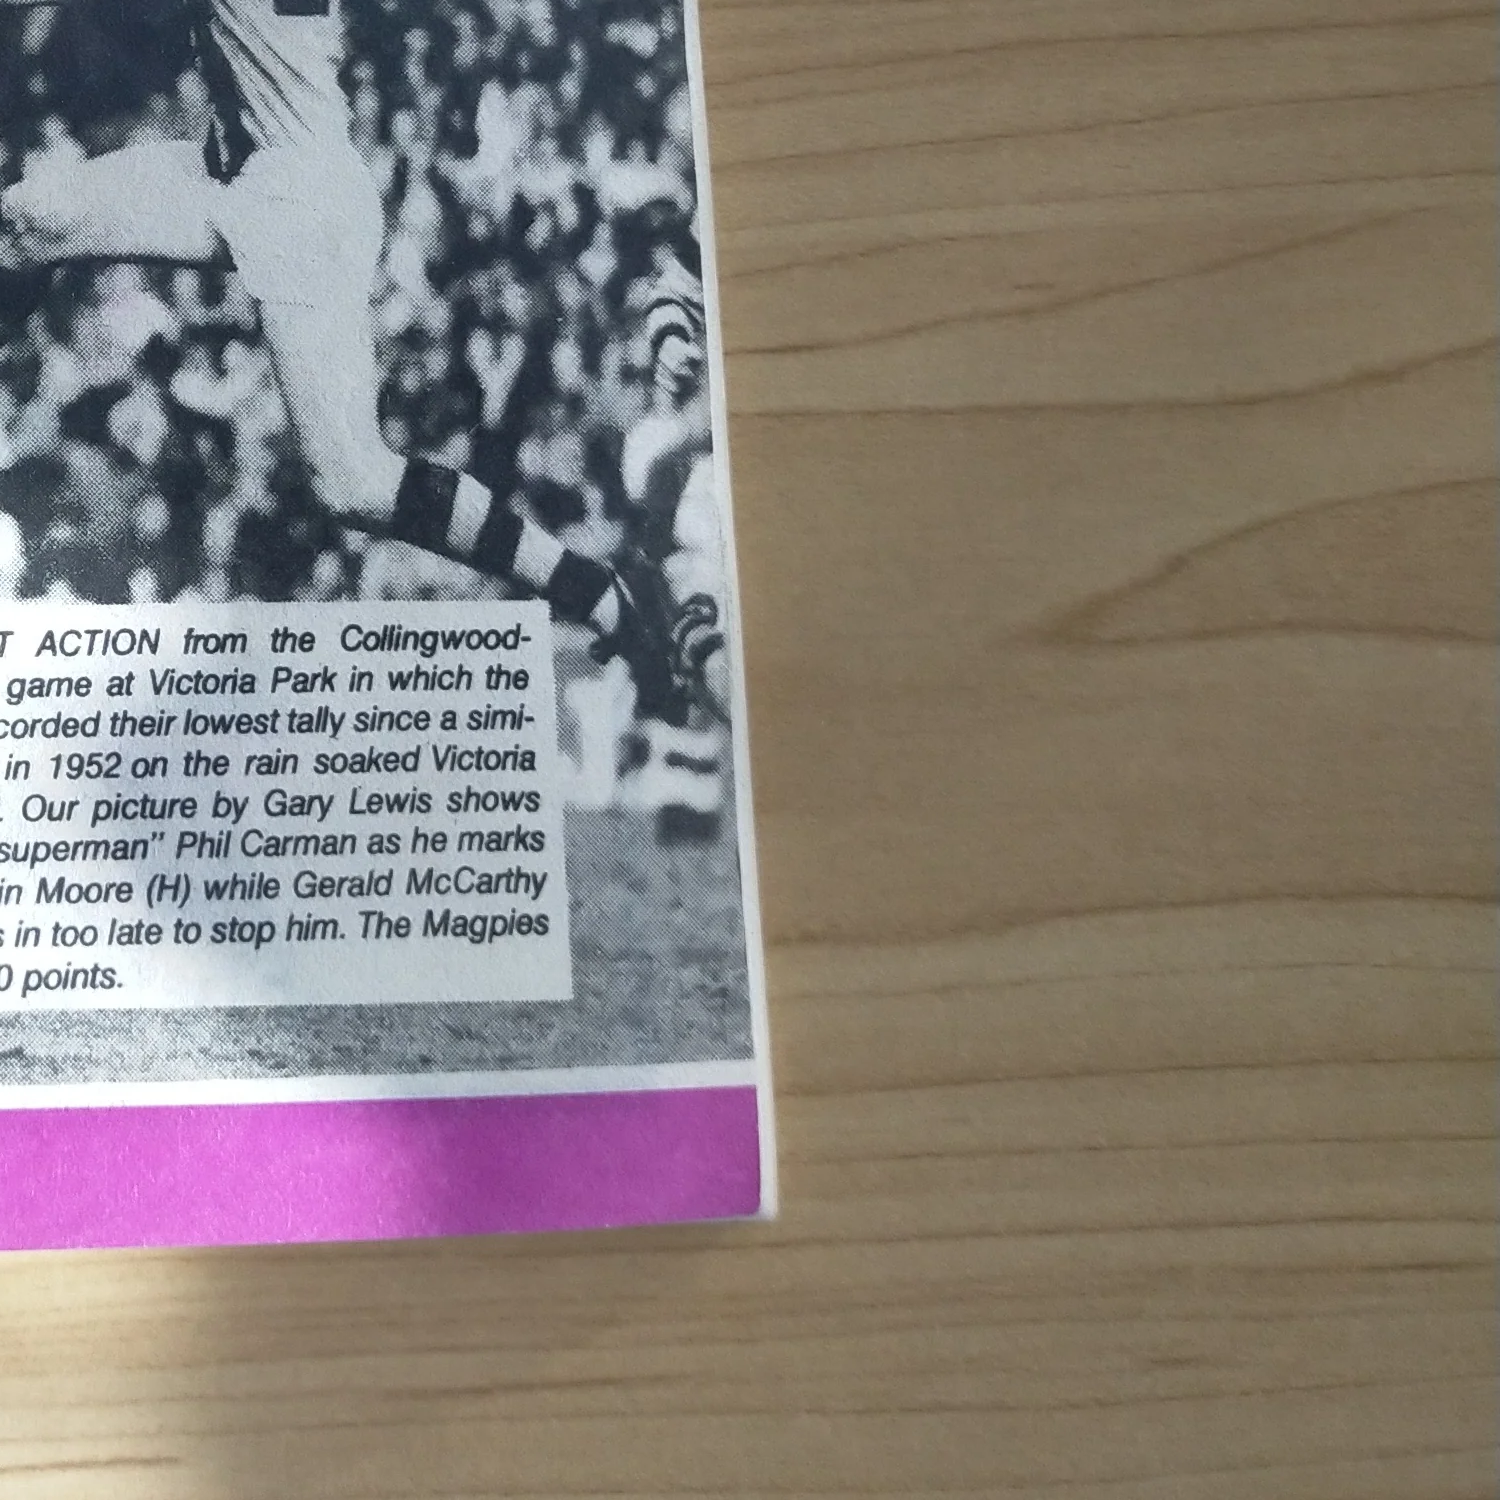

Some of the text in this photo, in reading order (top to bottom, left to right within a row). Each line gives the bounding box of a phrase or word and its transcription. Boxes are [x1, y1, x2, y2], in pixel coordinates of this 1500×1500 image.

[36, 628, 160, 657] ACTION
[184, 628, 247, 654] from
[271, 627, 315, 653] the
[341, 623, 531, 658] Collingwood-
[7, 677, 92, 705] game
[106, 672, 135, 697] at
[150, 667, 256, 695] Victoria
[271, 666, 337, 693] Park
[349, 666, 374, 692] in
[388, 664, 472, 691] which
[486, 664, 529, 690] the
[110, 710, 177, 737] their
[184, 709, 280, 735] lowest
[287, 706, 345, 739] tally
[354, 706, 431, 733] since
[440, 710, 457, 731] a
[467, 704, 534, 731] simi-
[5, 754, 30, 780] in
[51, 752, 122, 780] 1952
[131, 757, 168, 779] on
[184, 750, 229, 777] the
[245, 748, 298, 775] rain
[314, 745, 421, 774] soaked
[432, 744, 536, 771] Victoria
[22, 794, 80, 822] Our
[91, 793, 197, 827] picture
[212, 791, 249, 825] by
[264, 789, 334, 822] Gary
[349, 787, 432, 814] Lewis
[447, 786, 540, 813] shows
[176, 830, 232, 859] Phil
[241, 829, 357, 857] Carman
[367, 833, 401, 855] as
[411, 826, 447, 853] he
[458, 824, 545, 852] marks
[36, 877, 133, 904] Moore
[147, 873, 191, 908] (H)
[204, 872, 280, 900] while
[293, 869, 393, 899] Gerald
[406, 866, 547, 900] McCarthy
[15, 920, 41, 947] in
[52, 922, 98, 947] too
[108, 918, 163, 946] late
[174, 918, 202, 944] to
[210, 917, 276, 950] stop
[286, 913, 345, 941] him.
[359, 911, 411, 939] The
[423, 908, 549, 944] Magpies
[21, 962, 122, 998] points.
